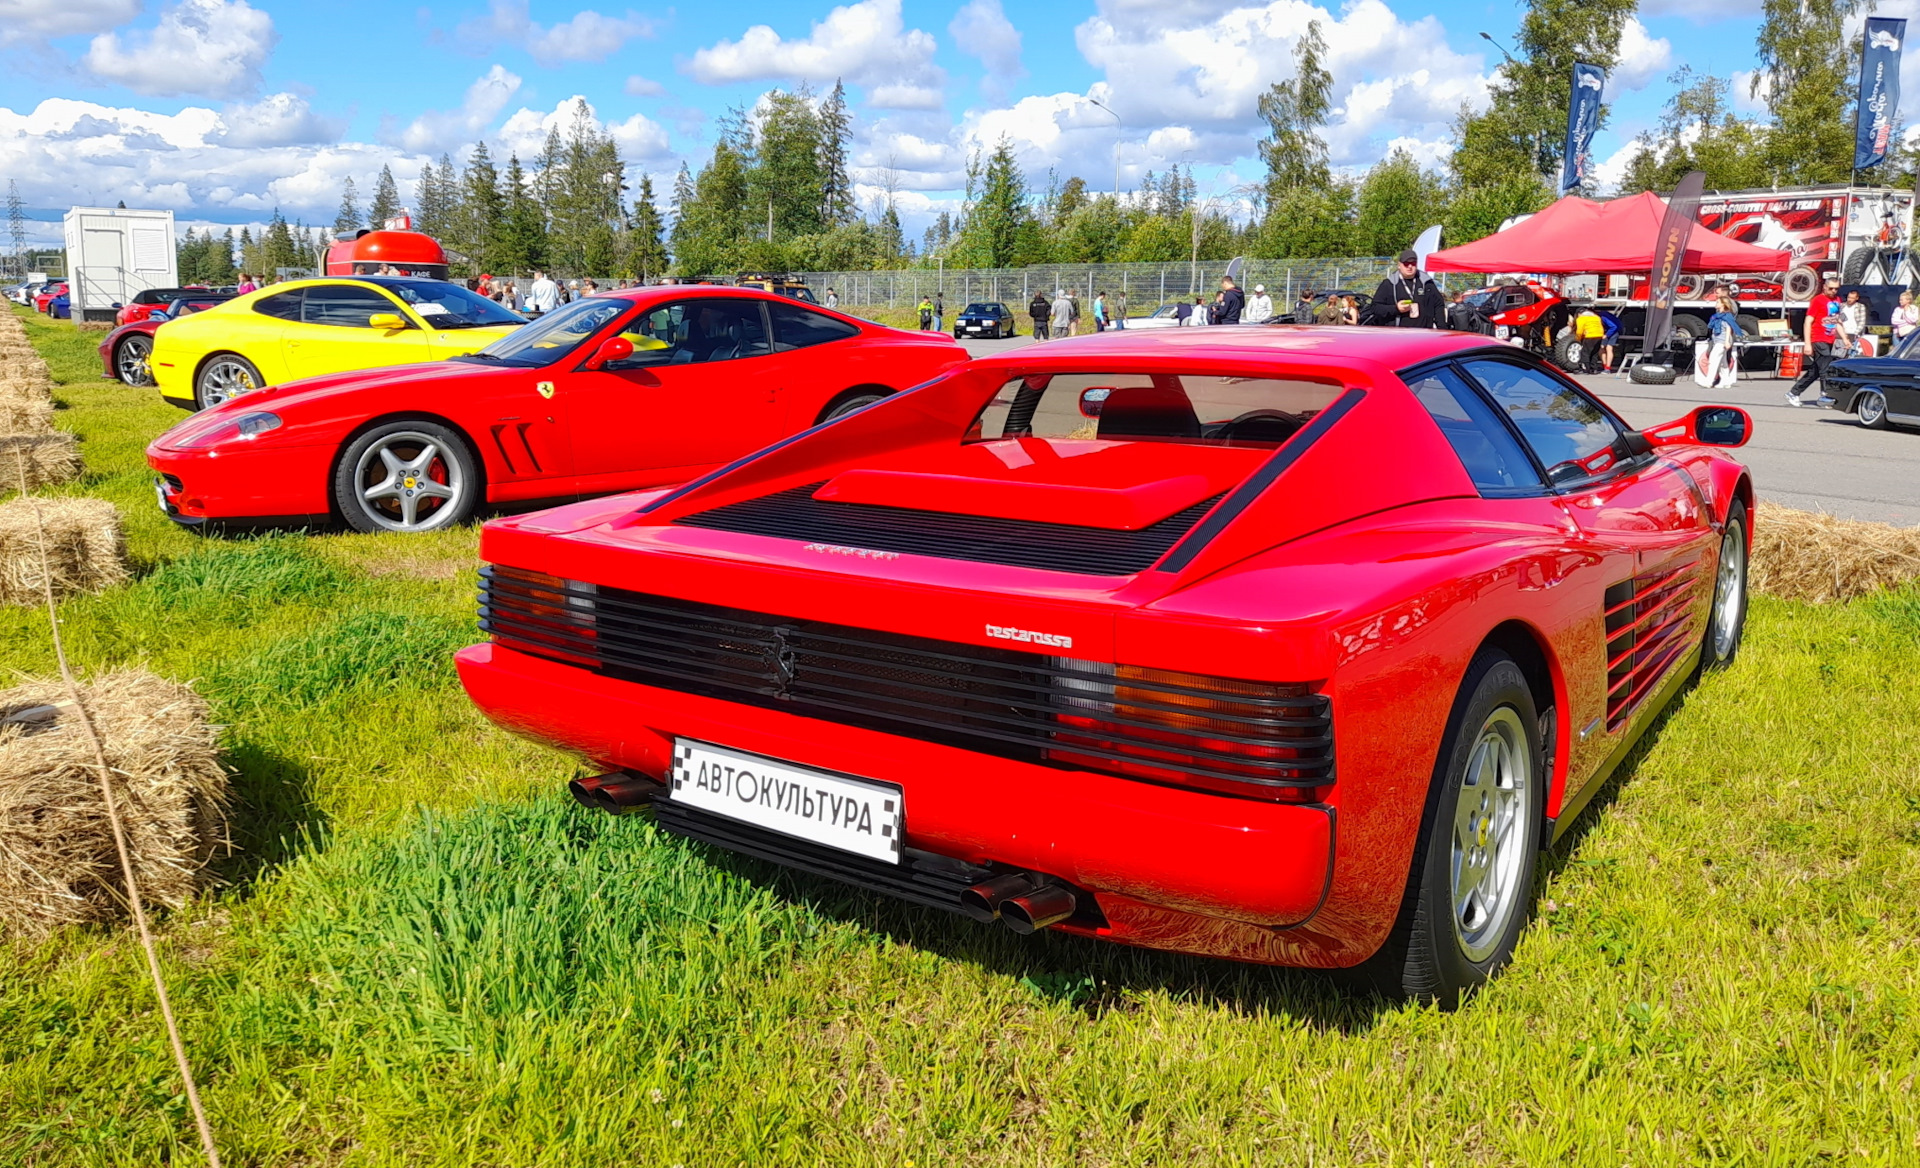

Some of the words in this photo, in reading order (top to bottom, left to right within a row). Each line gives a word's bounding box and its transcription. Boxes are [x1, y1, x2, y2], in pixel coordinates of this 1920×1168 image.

[1766, 200, 1795, 213] RALLY
[1795, 200, 1822, 210] TEAM
[411, 270, 431, 278] КАФЕ
[985, 623, 1073, 649] testarossa
[696, 760, 873, 836] АВТОКУЛЬТУРА
